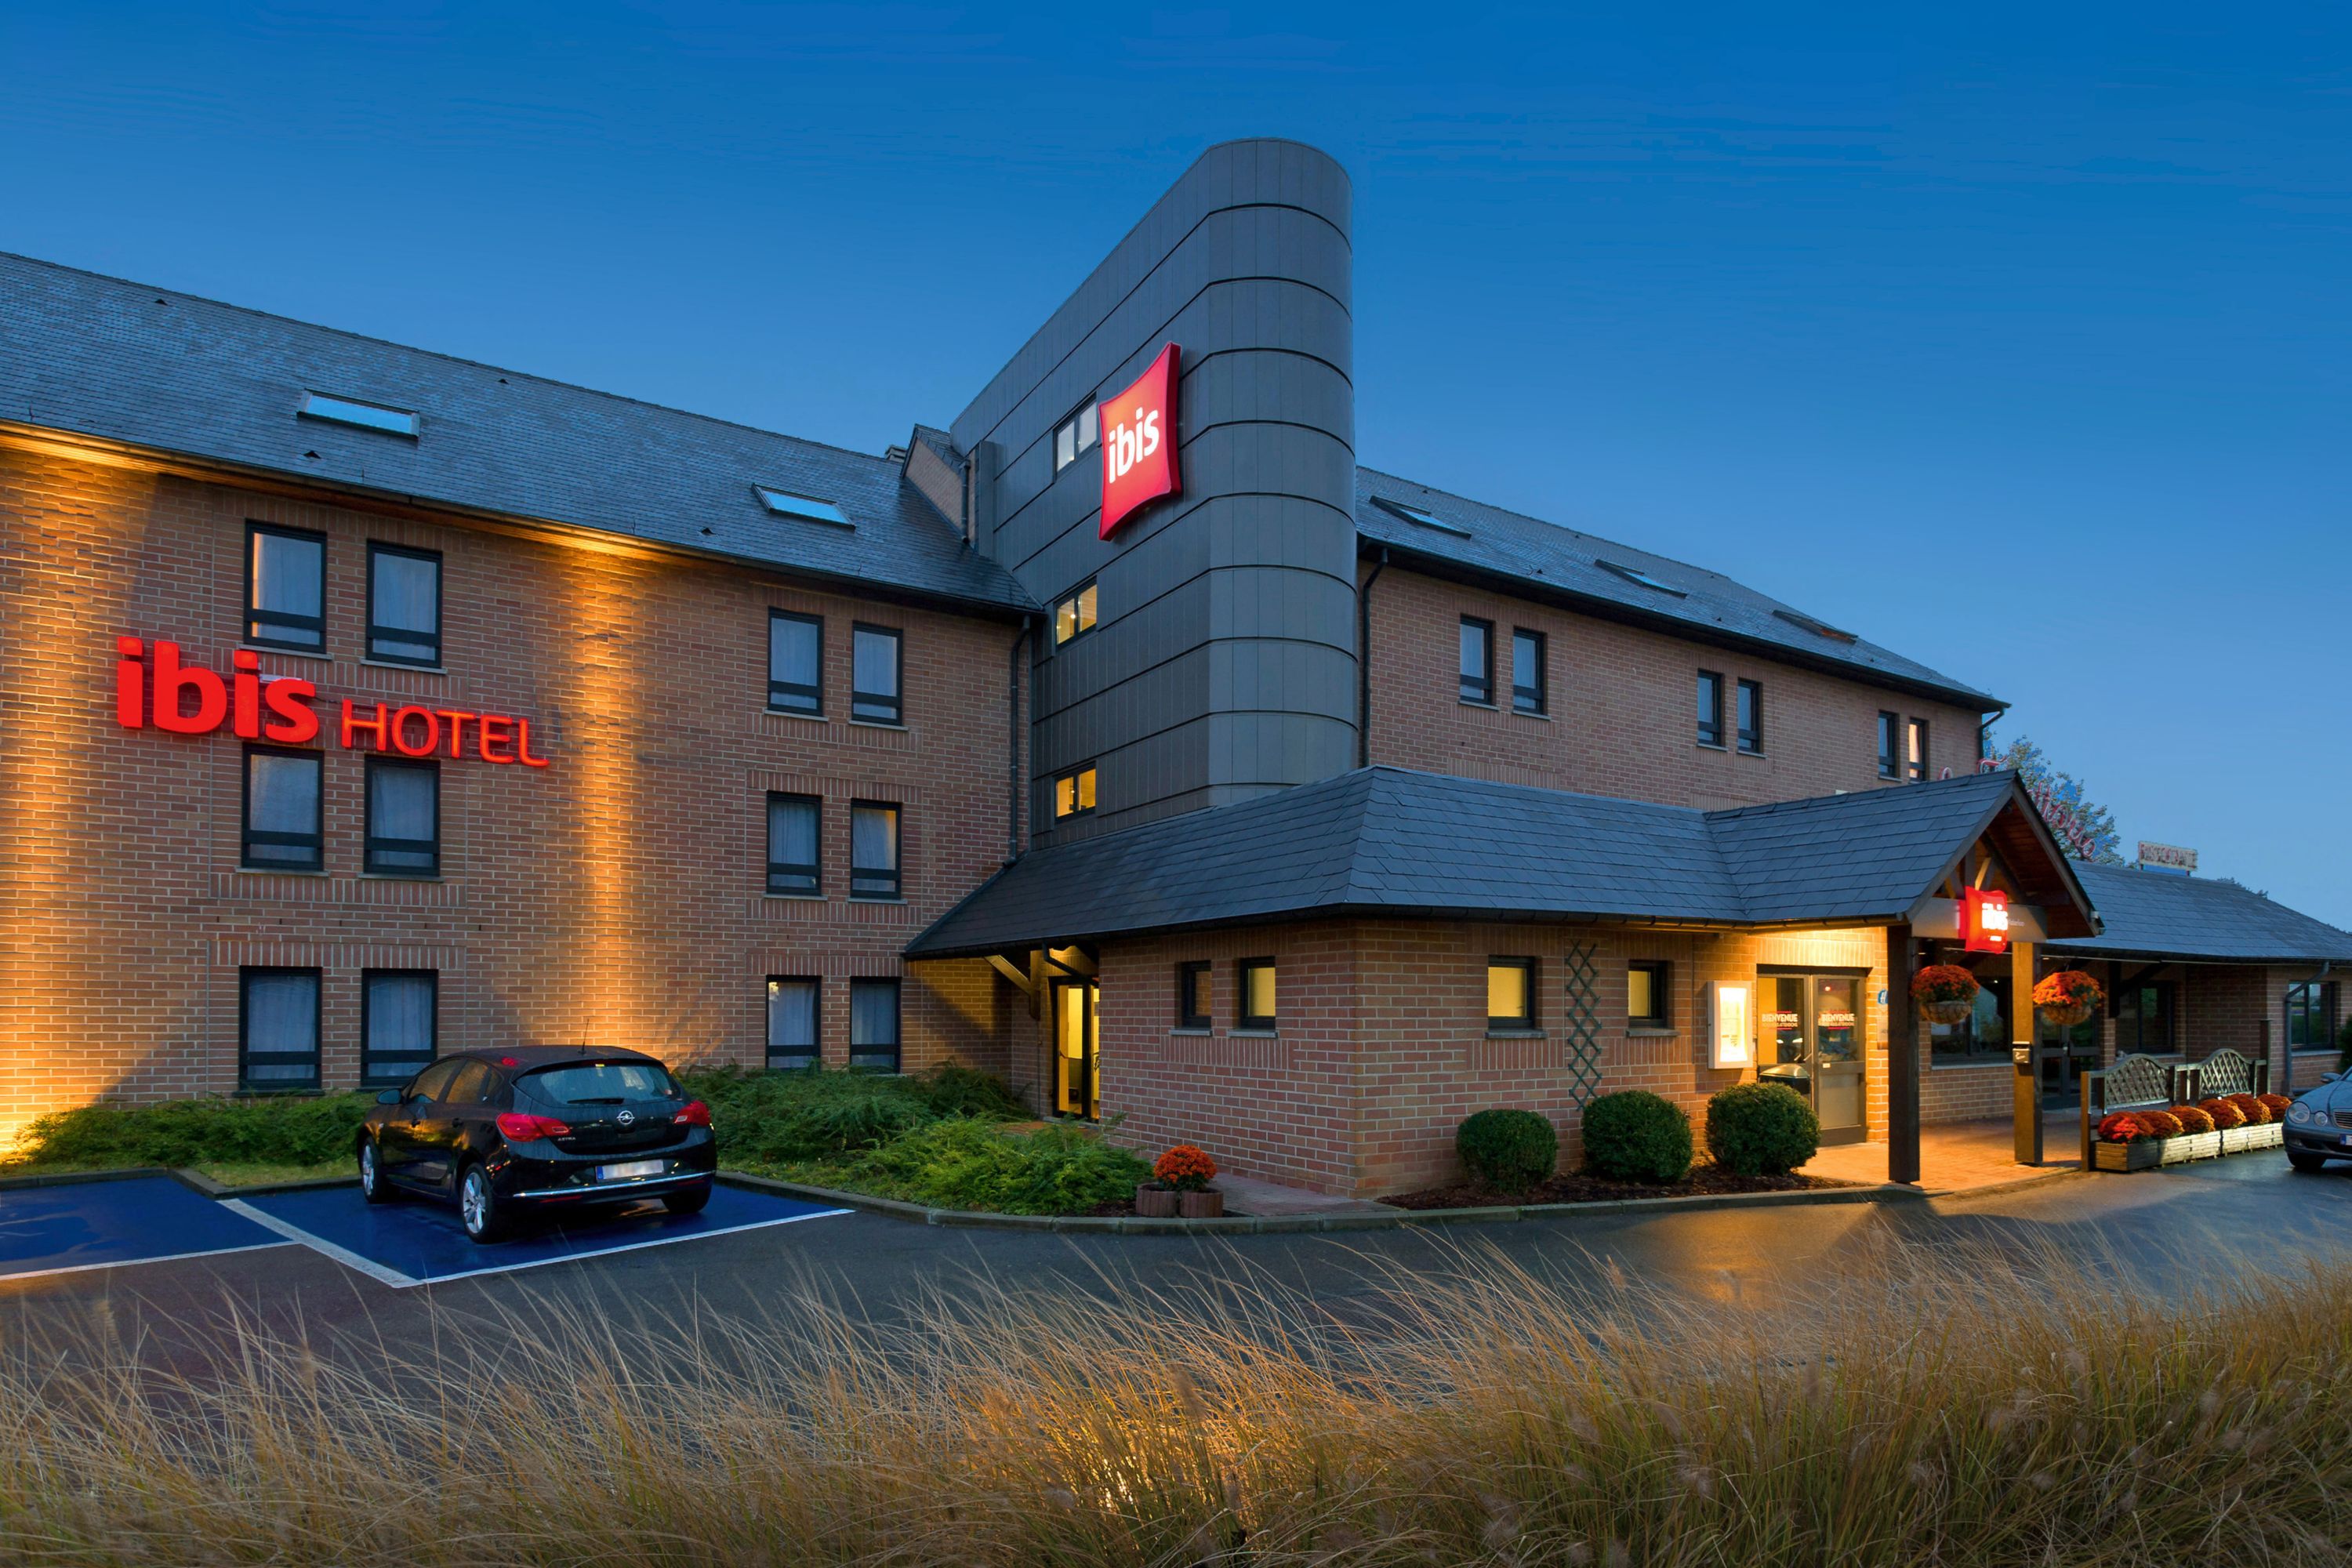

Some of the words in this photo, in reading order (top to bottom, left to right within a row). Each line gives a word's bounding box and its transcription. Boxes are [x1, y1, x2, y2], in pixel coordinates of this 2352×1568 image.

[1109, 407, 1160, 484] ibis
[117, 636, 319, 743] ibis
[342, 699, 550, 767] HOTEL
